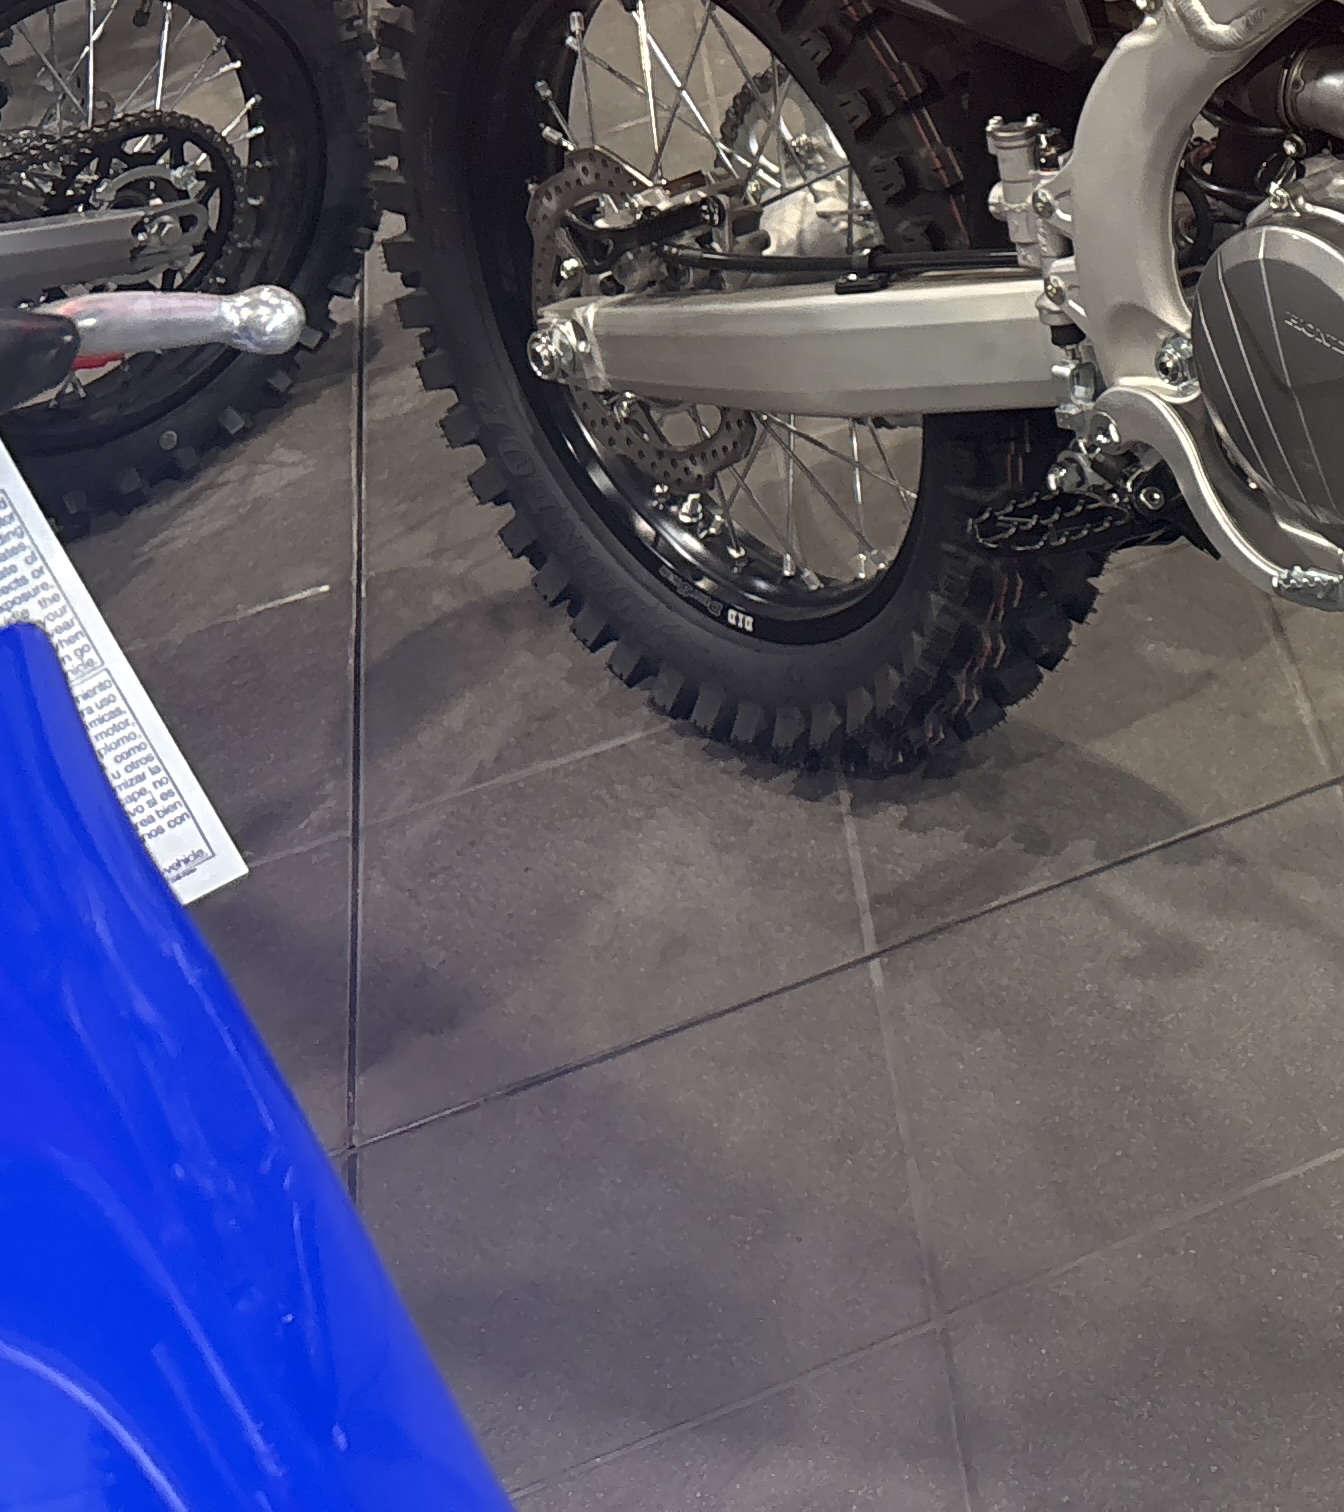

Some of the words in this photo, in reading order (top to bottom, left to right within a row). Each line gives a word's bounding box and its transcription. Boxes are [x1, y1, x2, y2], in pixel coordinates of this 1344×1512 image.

[113, 741, 149, 765] como
[123, 751, 155, 775] otros
[154, 799, 183, 821] bien
[166, 810, 191, 830] con
